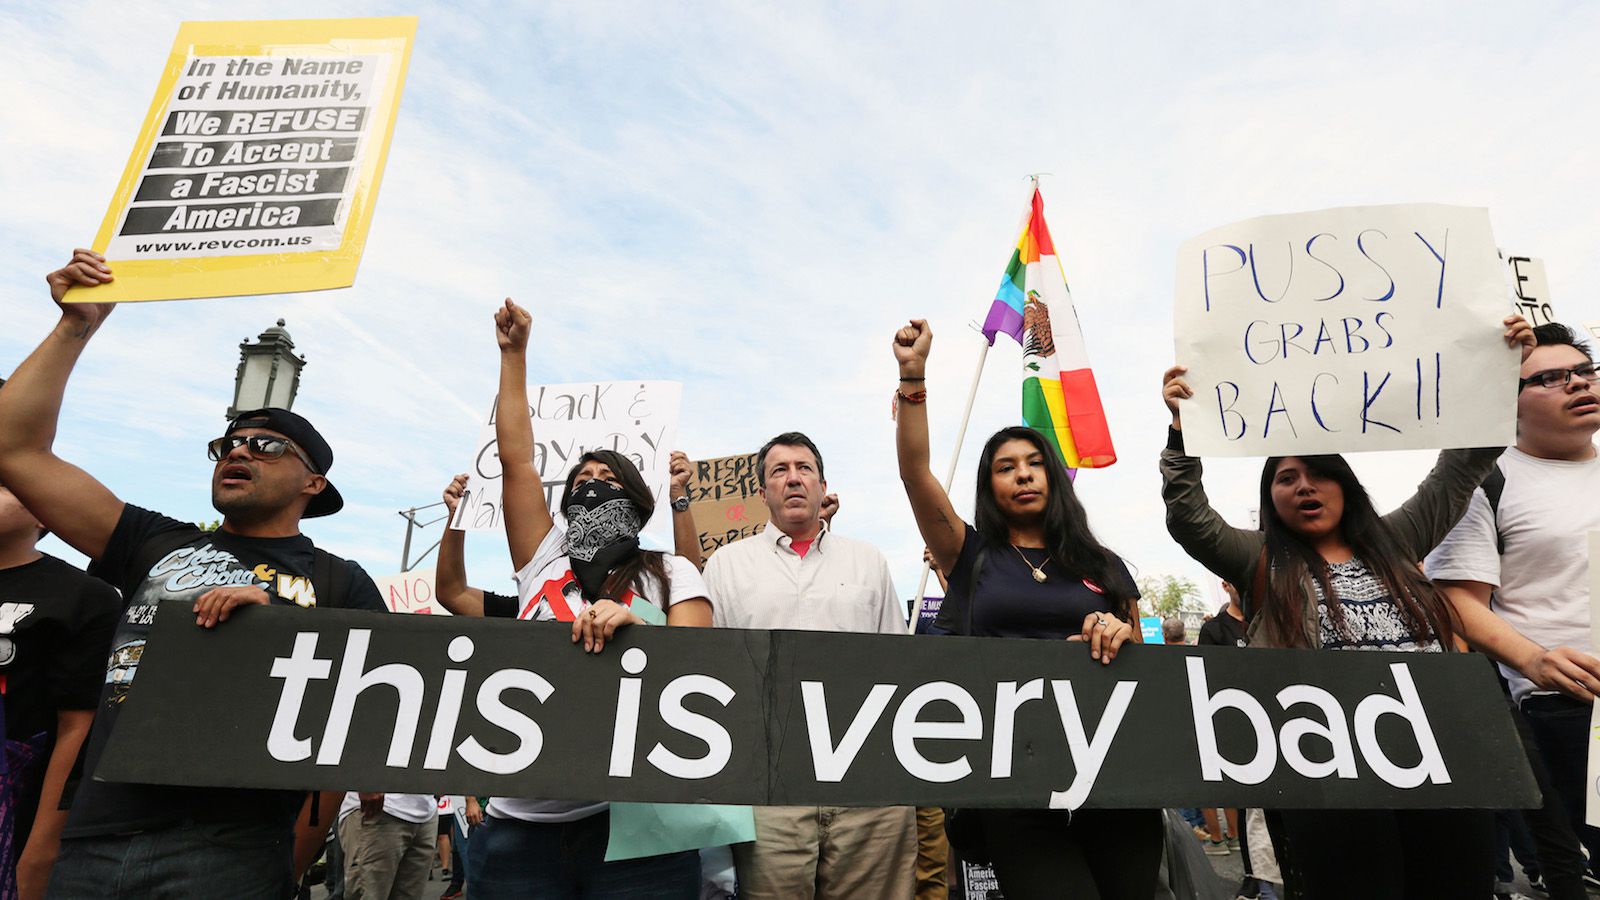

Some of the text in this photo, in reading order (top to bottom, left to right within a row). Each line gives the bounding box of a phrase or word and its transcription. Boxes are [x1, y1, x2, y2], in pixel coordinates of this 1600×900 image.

[187, 56, 363, 77] In the Name
[177, 78, 362, 102] of Humanity,
[174, 107, 361, 136] We REFUSE
[181, 139, 335, 167] To Accept
[169, 168, 319, 199] a Fascist
[162, 202, 302, 231] America
[135, 235, 313, 254] www.revcom.us
[1202, 227, 1450, 313] PUSSY
[1244, 311, 1394, 366] GRABS
[725, 503, 750, 524] OR
[389, 577, 431, 613] NO
[266, 628, 1452, 811] this is very bad
[968, 879, 1000, 891] Fascist
